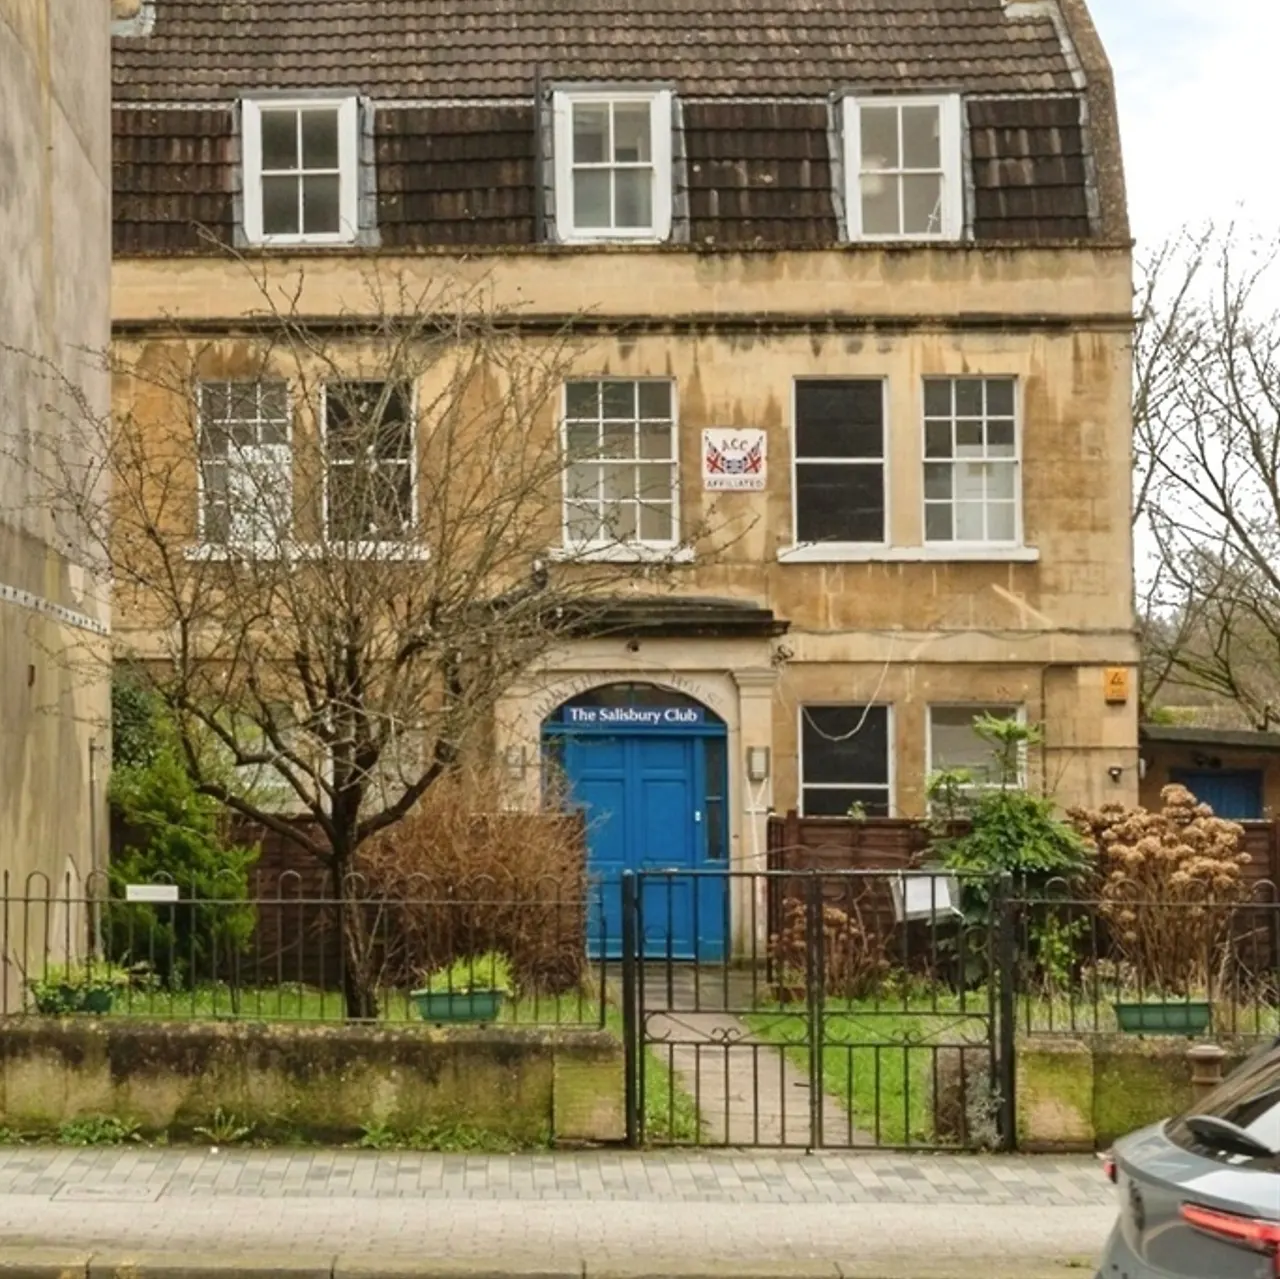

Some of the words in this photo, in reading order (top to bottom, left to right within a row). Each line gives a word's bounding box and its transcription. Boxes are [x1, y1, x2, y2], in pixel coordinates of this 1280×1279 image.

[569, 708, 597, 722] The
[599, 707, 662, 724] Salisbury
[663, 707, 698, 722] Club
